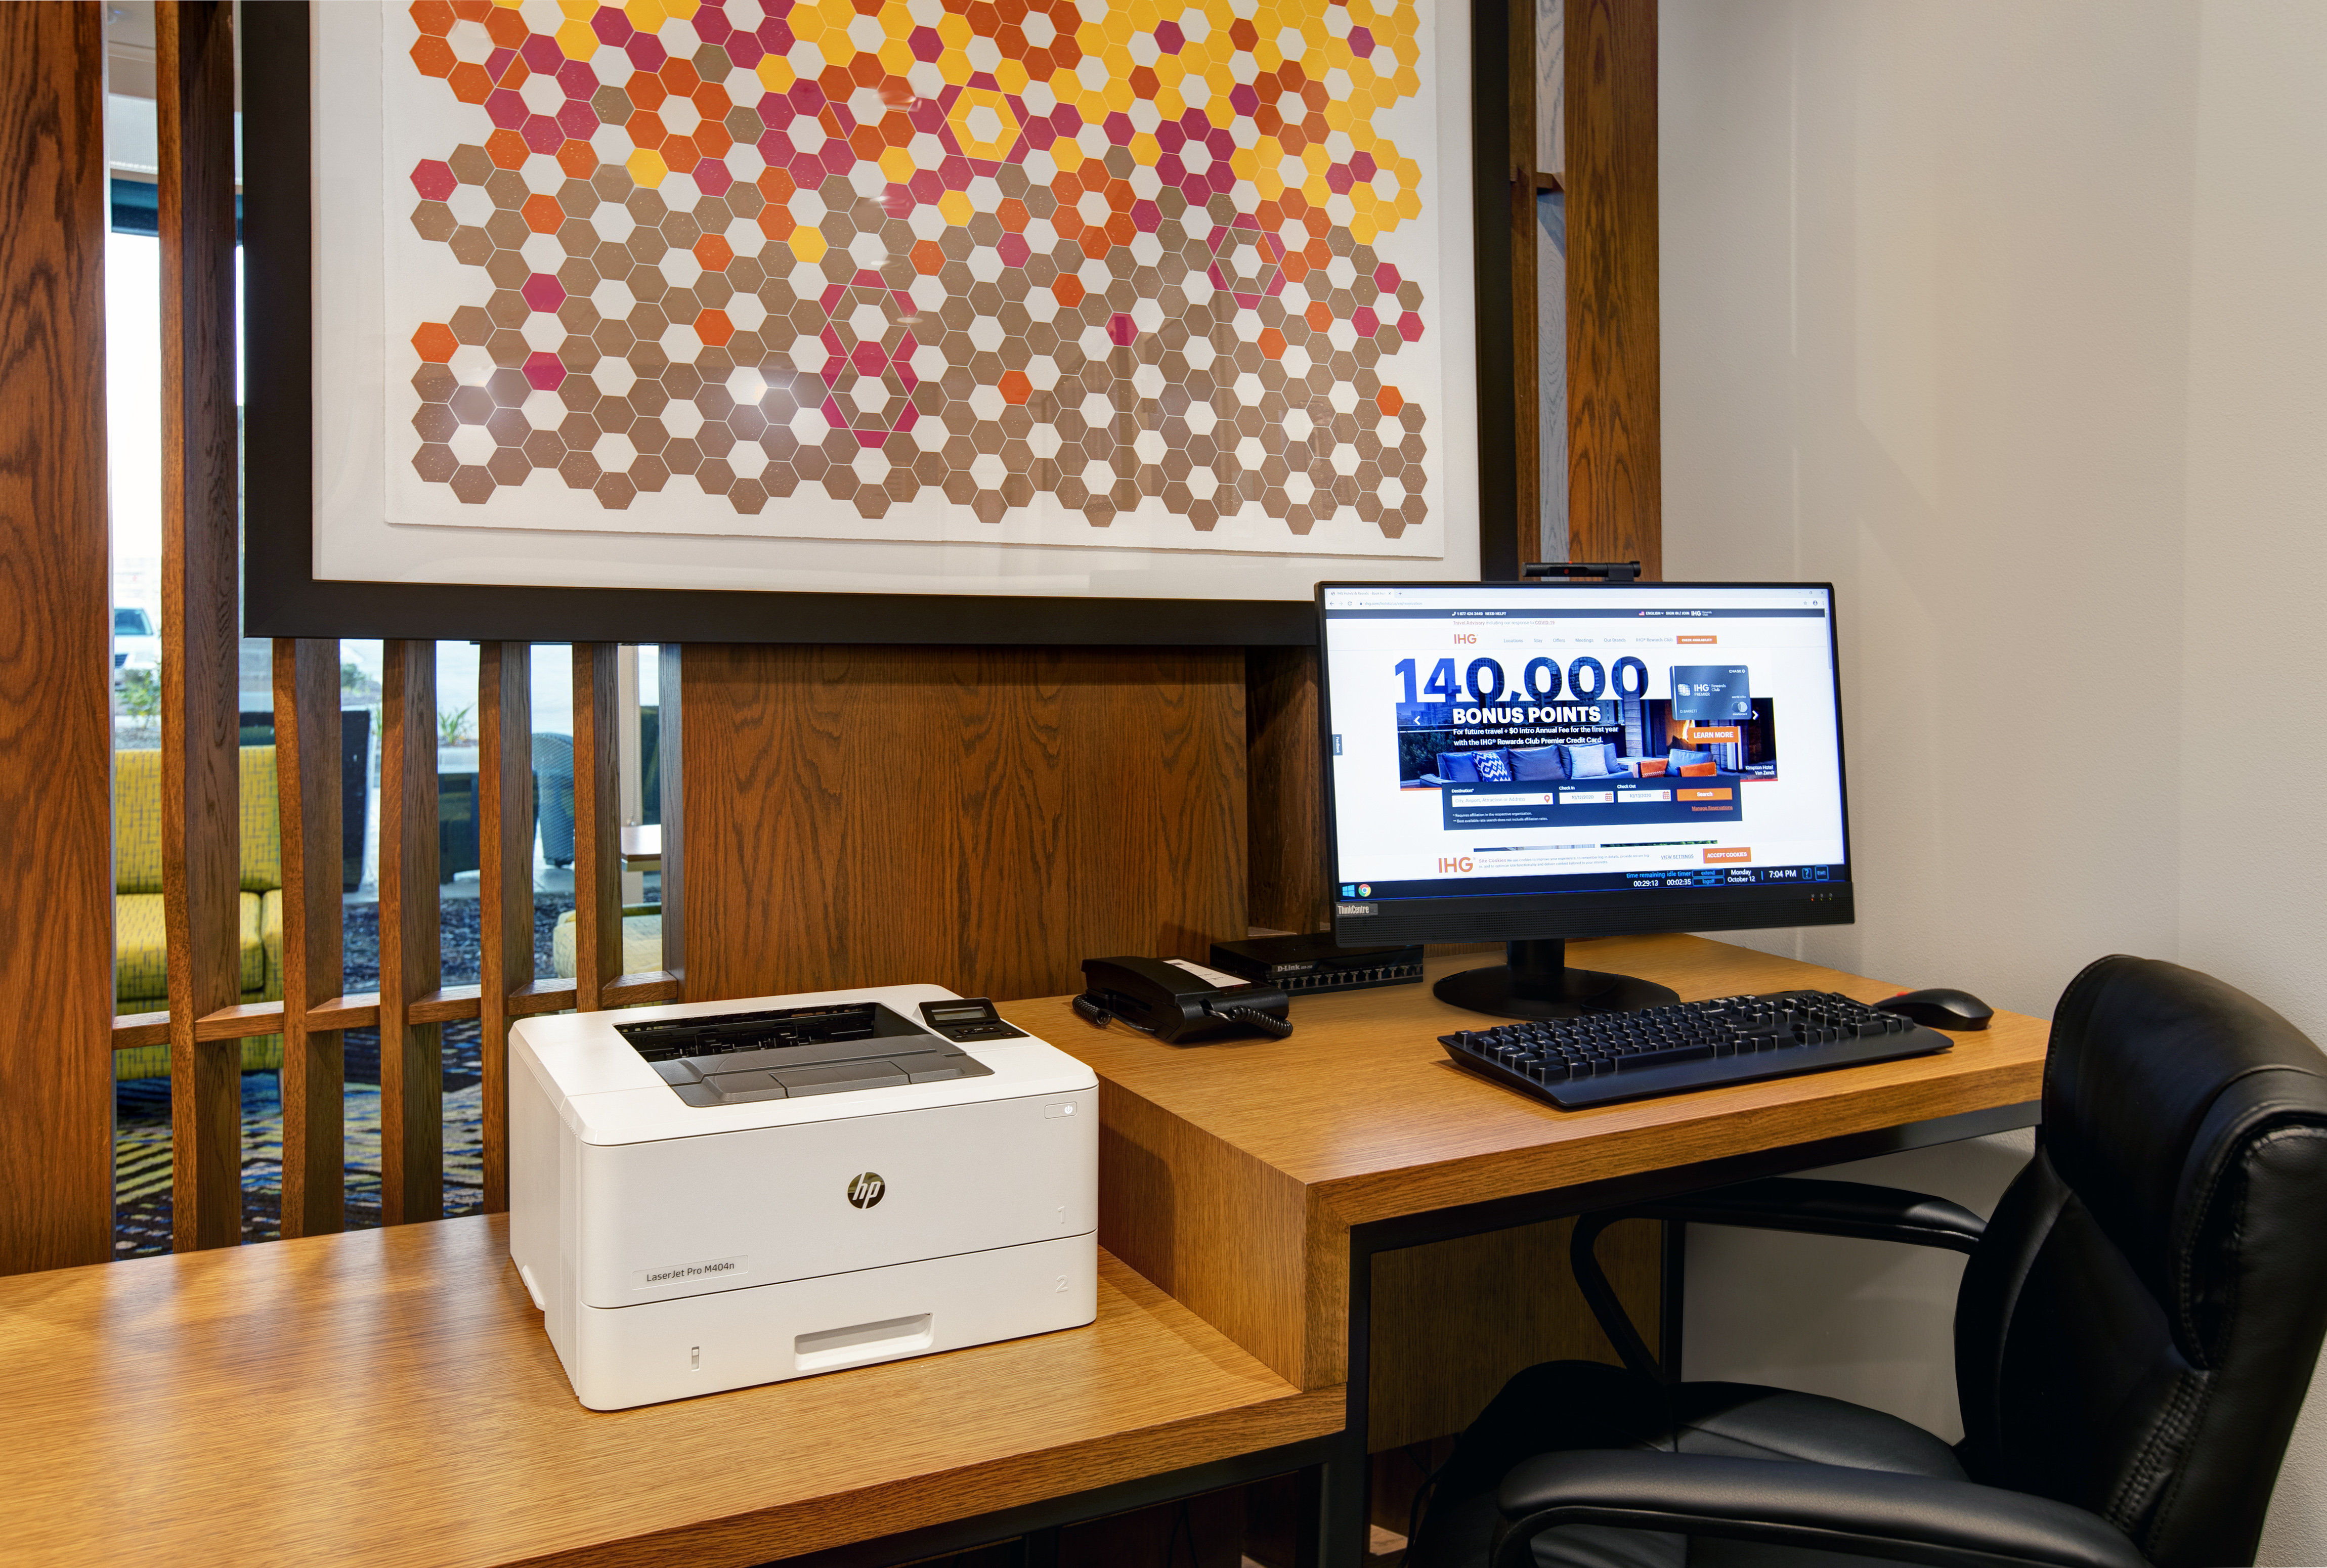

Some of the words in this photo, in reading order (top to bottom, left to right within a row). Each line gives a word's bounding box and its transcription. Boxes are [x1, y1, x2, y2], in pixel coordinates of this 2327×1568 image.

[1395, 656, 1649, 704] 140,000
[1453, 707, 1525, 724] BONUS
[1528, 706, 1601, 723] POINTS
[1338, 905, 1369, 914] ThinkCentre
[852, 1172, 881, 1209] hp
[1057, 1206, 1065, 1224] 1
[647, 1270, 684, 1282] LaserJet
[687, 1268, 702, 1276] Pro
[705, 1262, 735, 1273] M404n
[1056, 1275, 1068, 1293] 2
